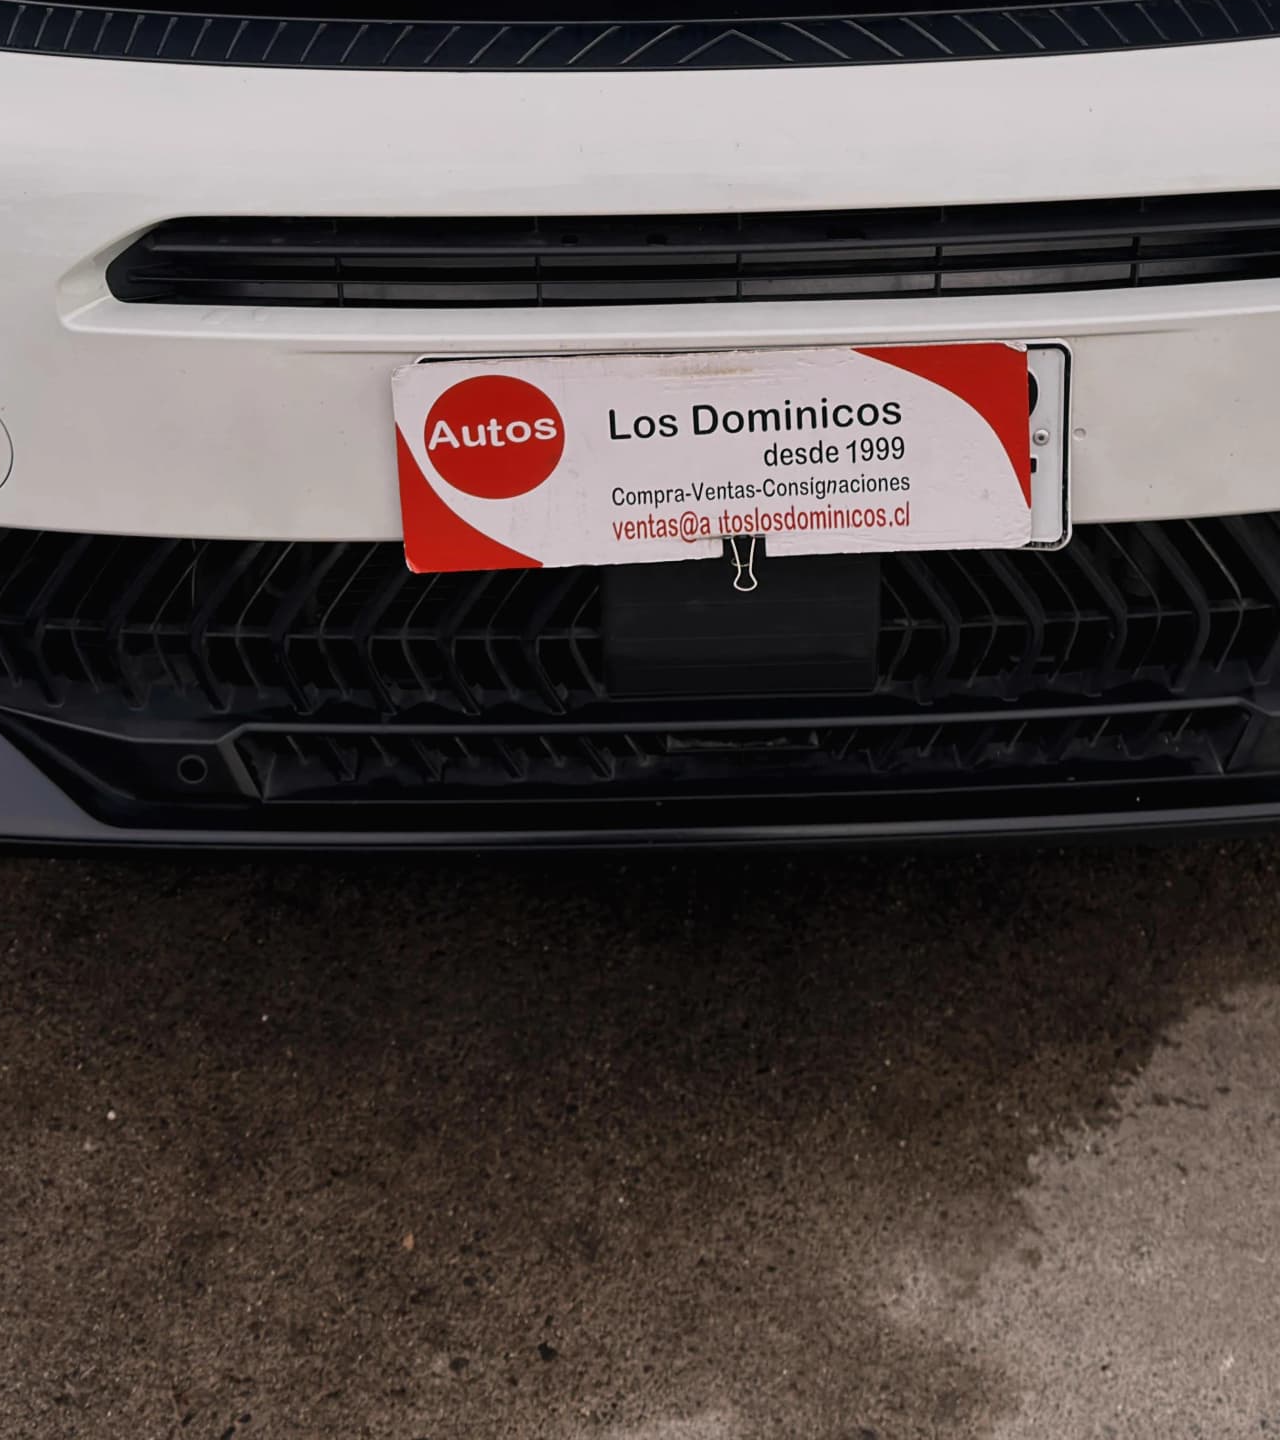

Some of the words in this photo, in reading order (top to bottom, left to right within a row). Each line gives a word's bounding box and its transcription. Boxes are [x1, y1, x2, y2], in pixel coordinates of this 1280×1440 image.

[427, 417, 558, 452] Autos
[608, 409, 680, 441] Los
[691, 397, 904, 437] Dominicos
[763, 440, 841, 468] desde
[845, 435, 906, 464] 1999
[611, 473, 912, 509] Compra-Ventas-Consignaciones
